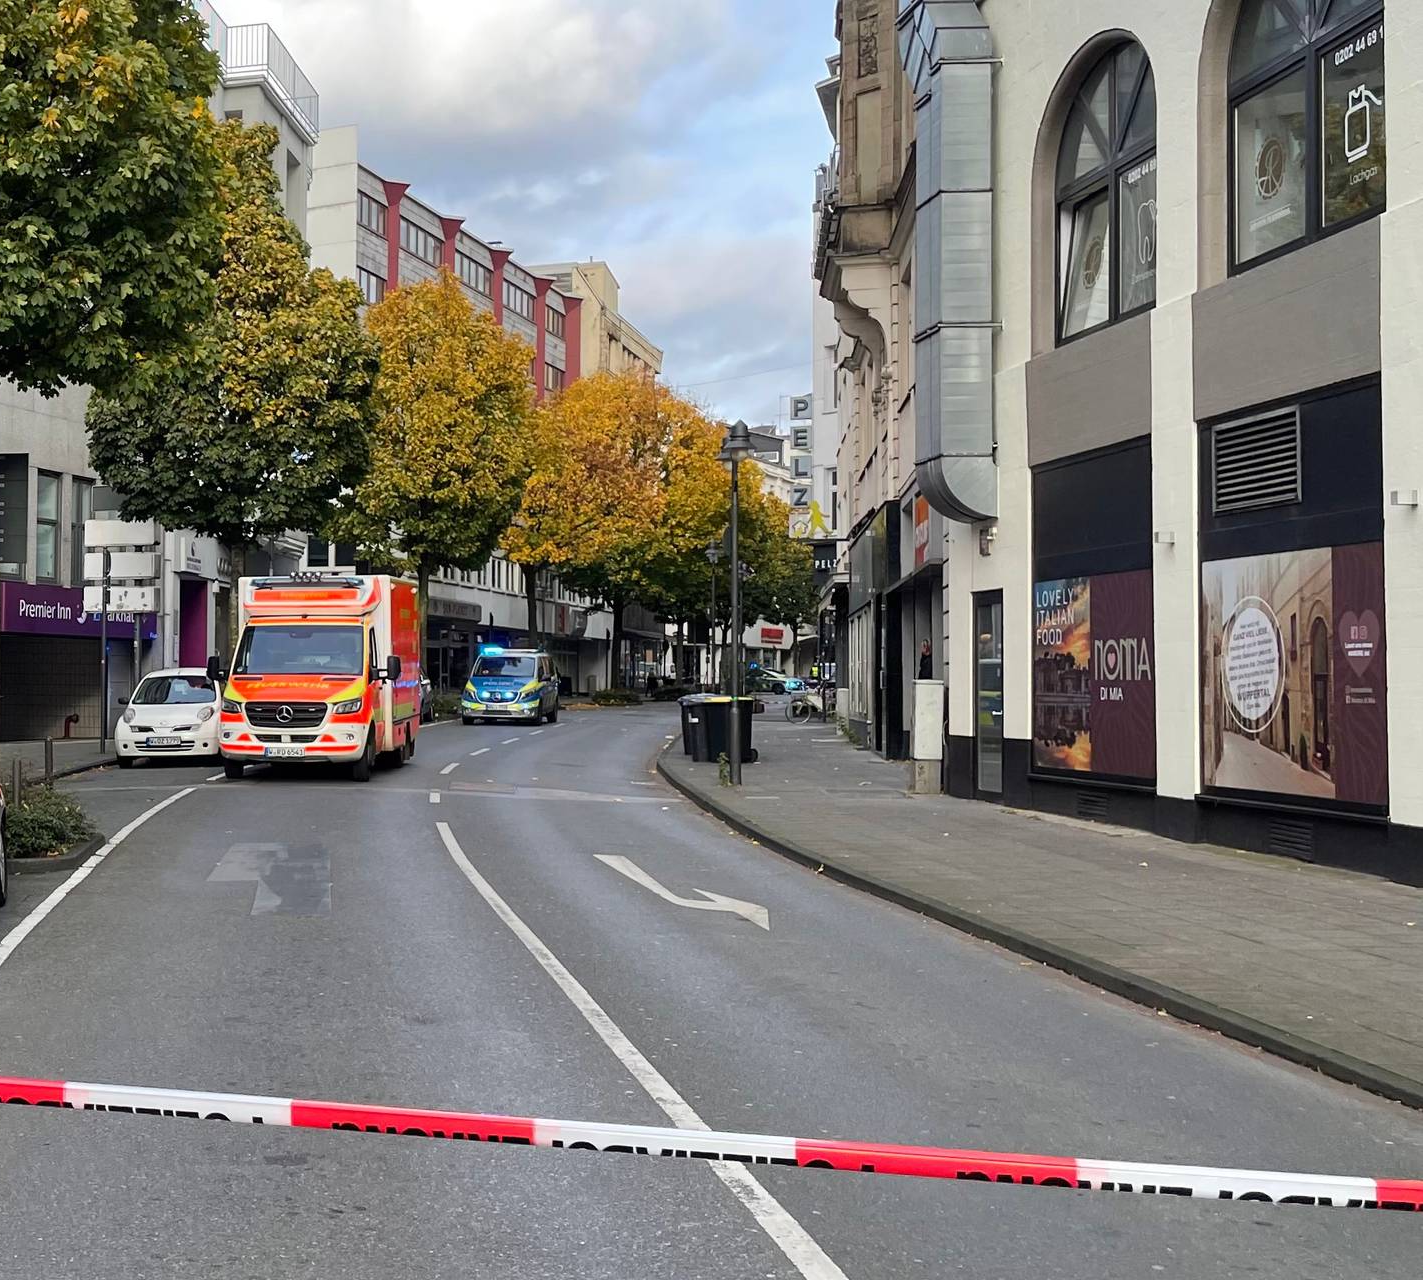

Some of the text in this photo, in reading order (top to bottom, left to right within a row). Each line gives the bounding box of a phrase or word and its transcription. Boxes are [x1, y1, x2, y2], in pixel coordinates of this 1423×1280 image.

[1334, 43, 1354, 66] 0202
[1355, 36, 1365, 53] 44
[1366, 29, 1377, 47] 69
[793, 398, 809, 507] PELZ
[1036, 587, 1074, 608] LOVELY
[19, 599, 72, 620] Premier Inn
[1036, 607, 1075, 626] ITALIAN
[1036, 628, 1063, 646] FOOD
[1100, 686, 1124, 702] DI MIA
